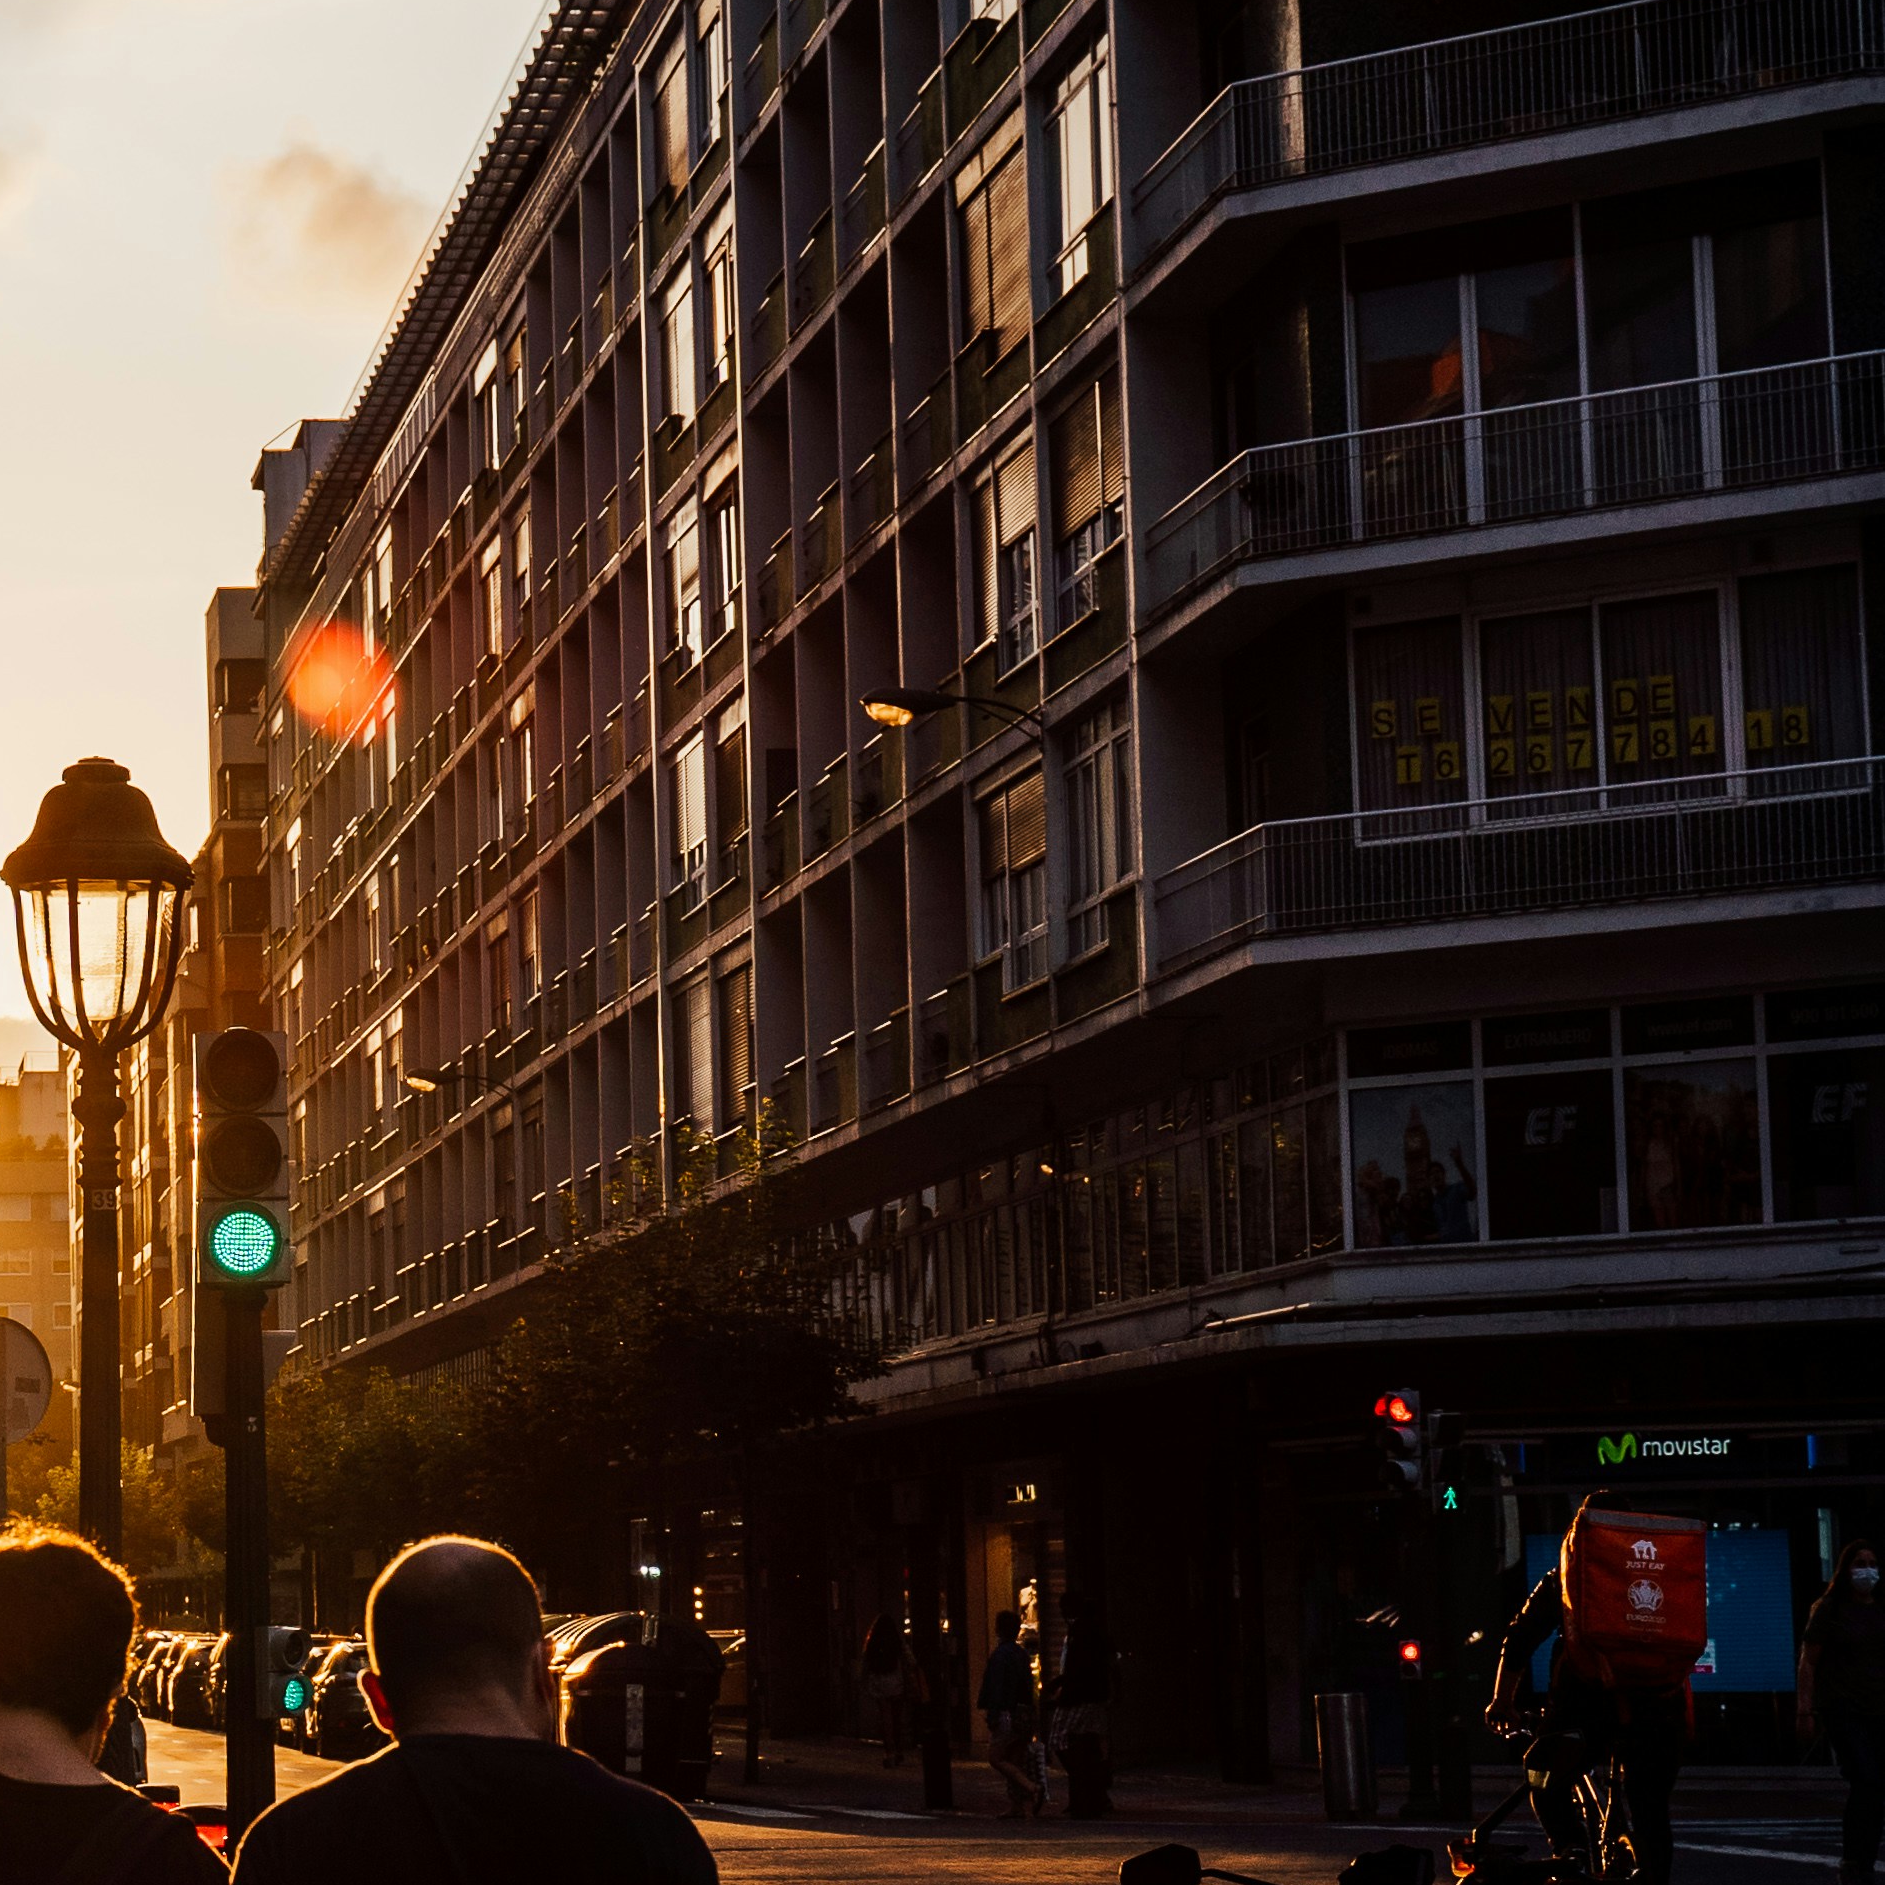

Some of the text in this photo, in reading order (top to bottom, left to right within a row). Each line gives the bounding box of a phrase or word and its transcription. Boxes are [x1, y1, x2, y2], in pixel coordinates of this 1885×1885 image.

[1373, 680, 1673, 737] SE VENDE
[1382, 1040, 1439, 1060] IDIOMAS
[1504, 1027, 1592, 1051] EXTRANJERO
[1810, 1081, 1874, 1124] EF
[1523, 1106, 1579, 1145] EF
[1642, 1436, 1731, 1457] movistar
[1625, 1560, 1666, 1570] JUST EAT
